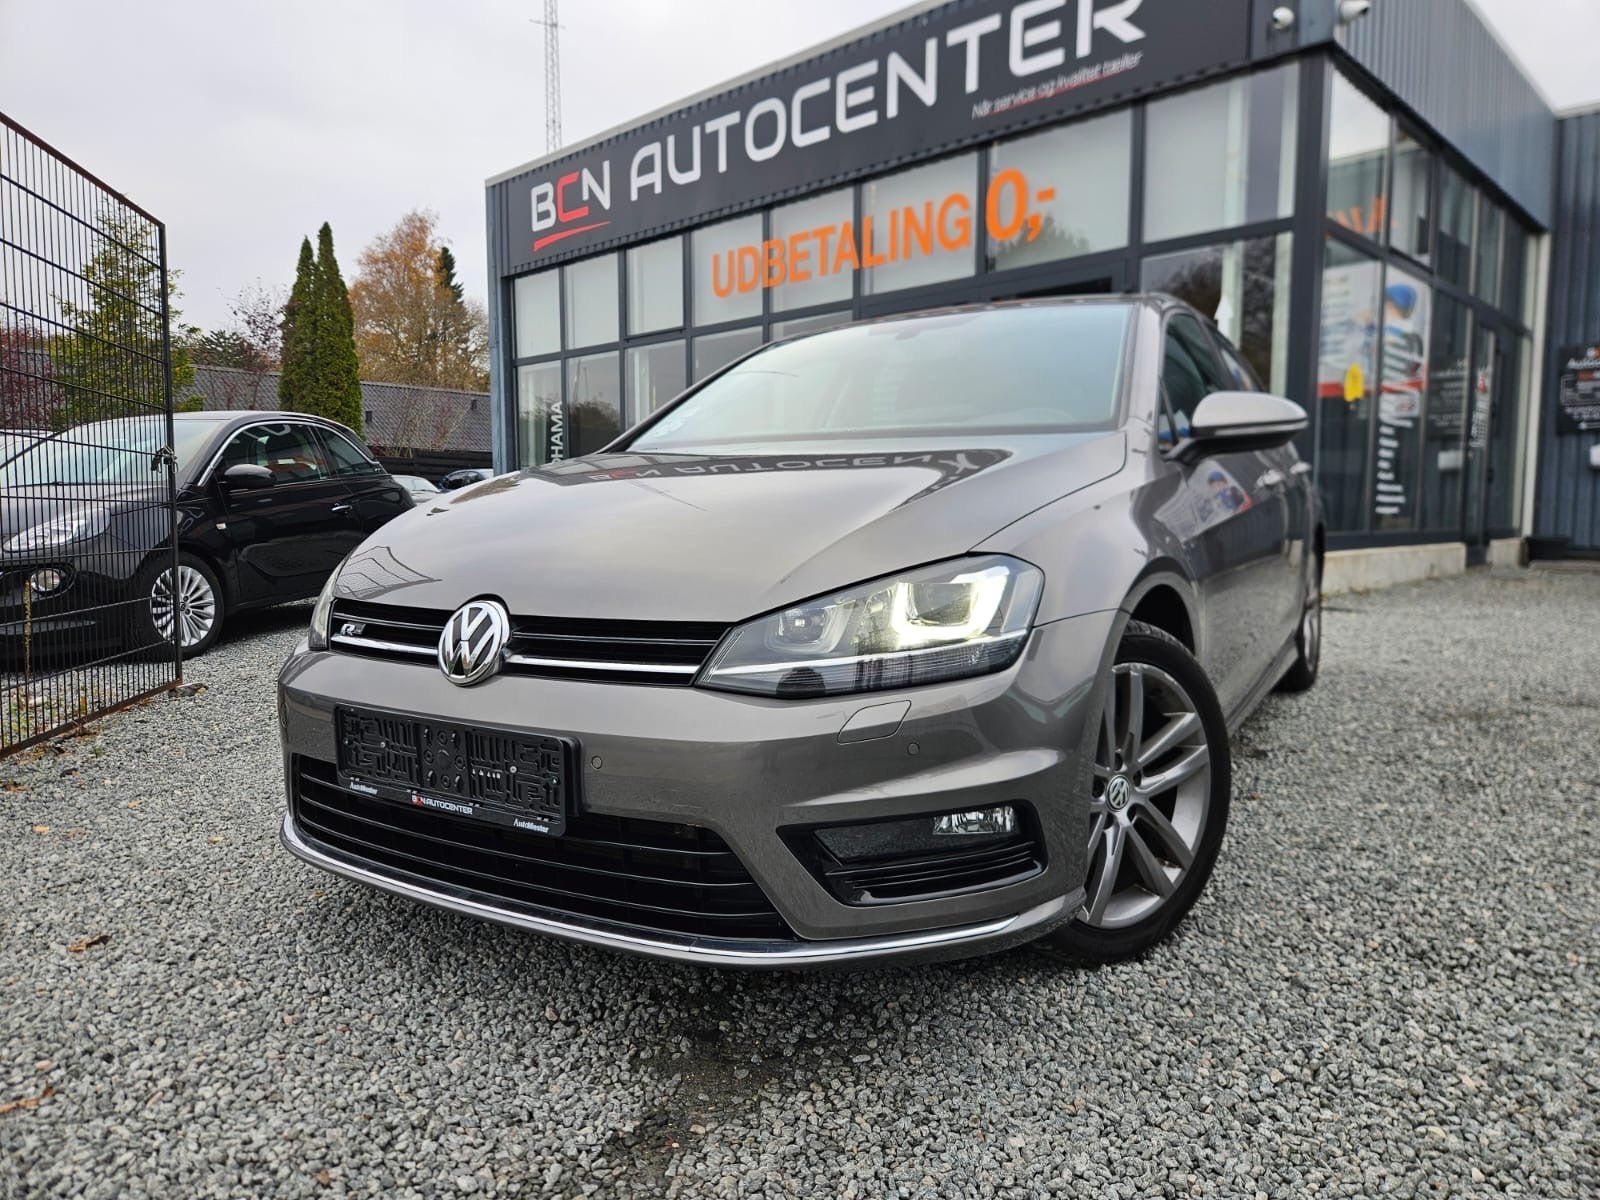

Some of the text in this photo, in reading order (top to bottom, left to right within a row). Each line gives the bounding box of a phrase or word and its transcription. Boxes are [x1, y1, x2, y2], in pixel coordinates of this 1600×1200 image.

[531, 0, 1146, 232] BCN AUTOCENTER
[712, 193, 971, 298] UDBETALING
[425, 797, 473, 816] AUTOCENTER
